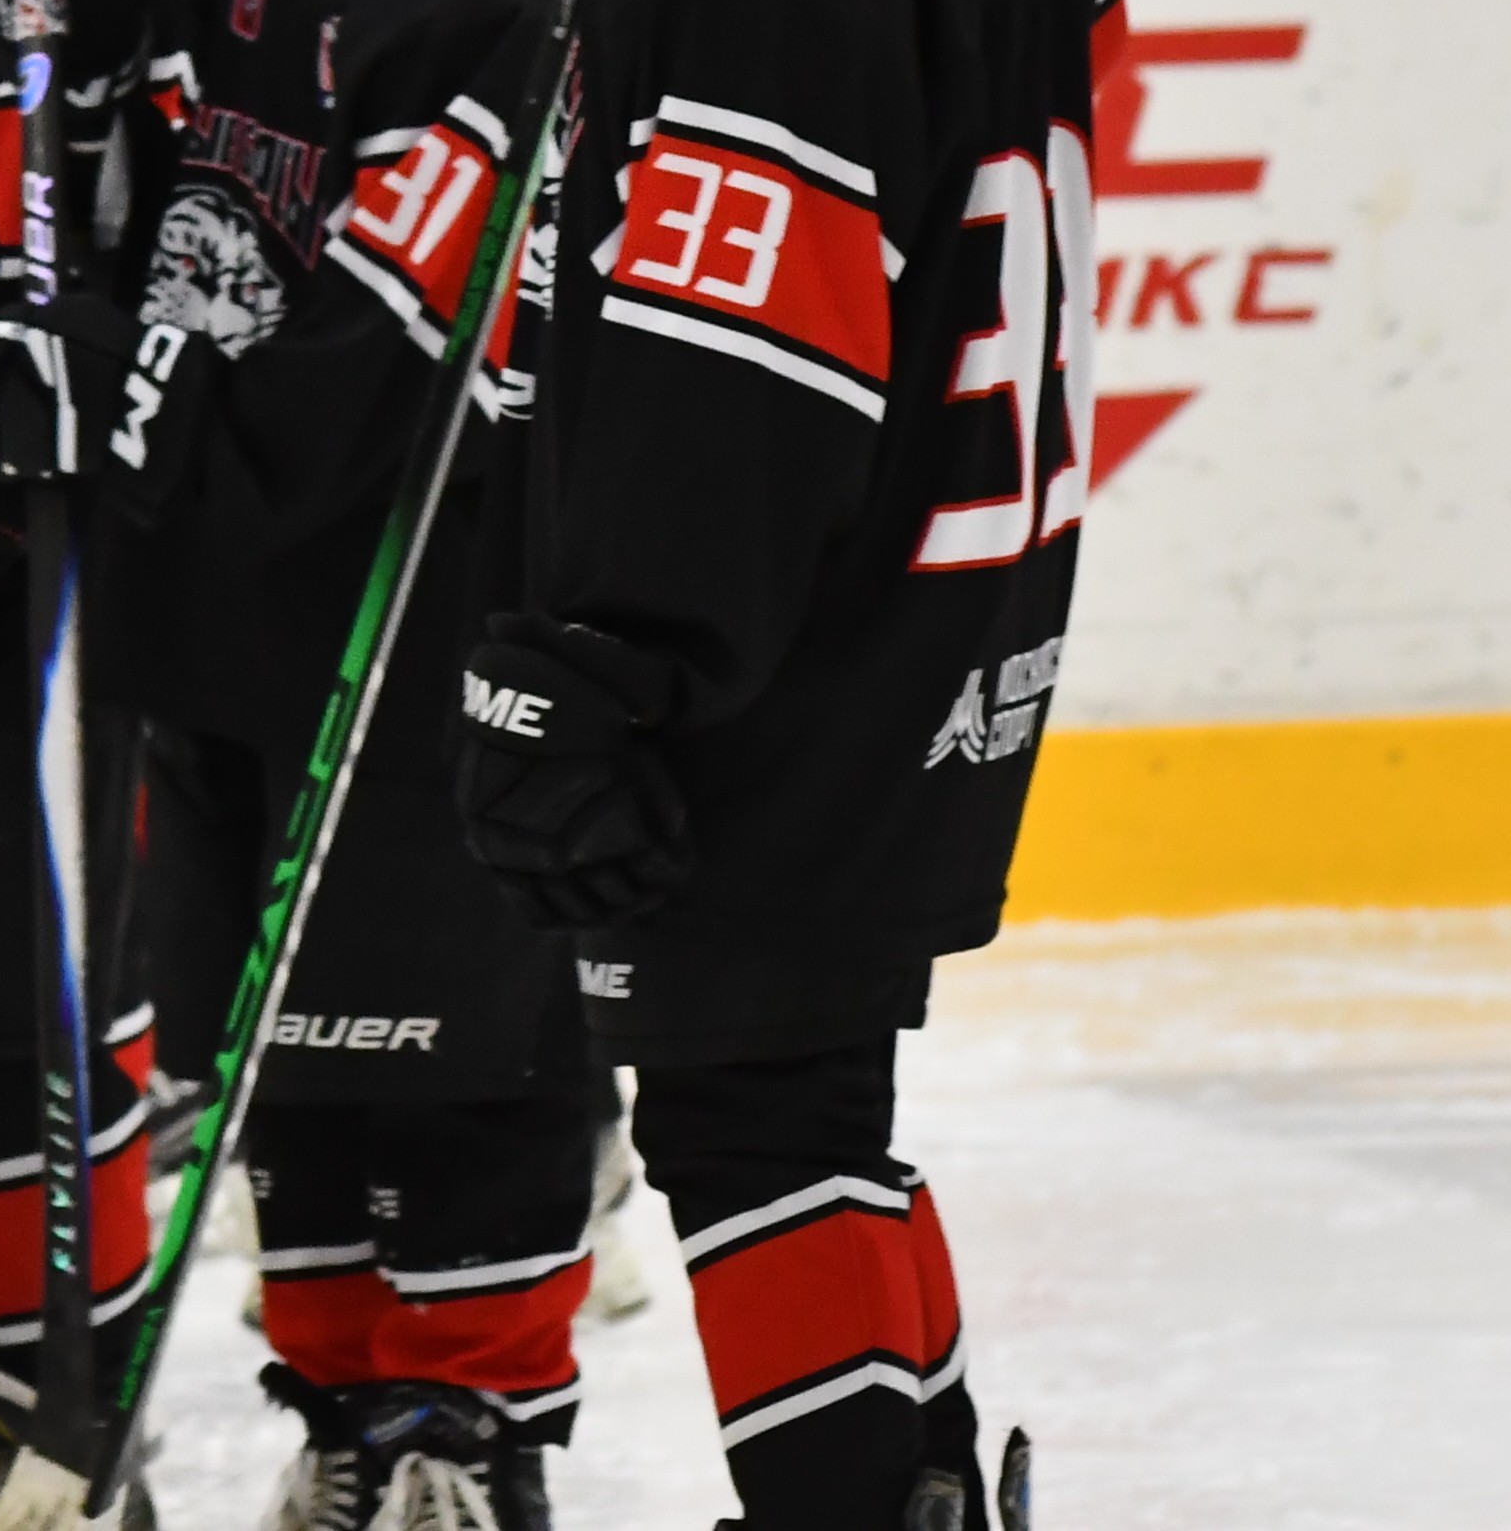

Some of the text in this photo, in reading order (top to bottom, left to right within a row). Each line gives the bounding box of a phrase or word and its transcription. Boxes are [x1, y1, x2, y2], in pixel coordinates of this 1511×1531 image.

[352, 132, 484, 266] 31
[628, 151, 794, 309] 33
[108, 323, 189, 471] CM
